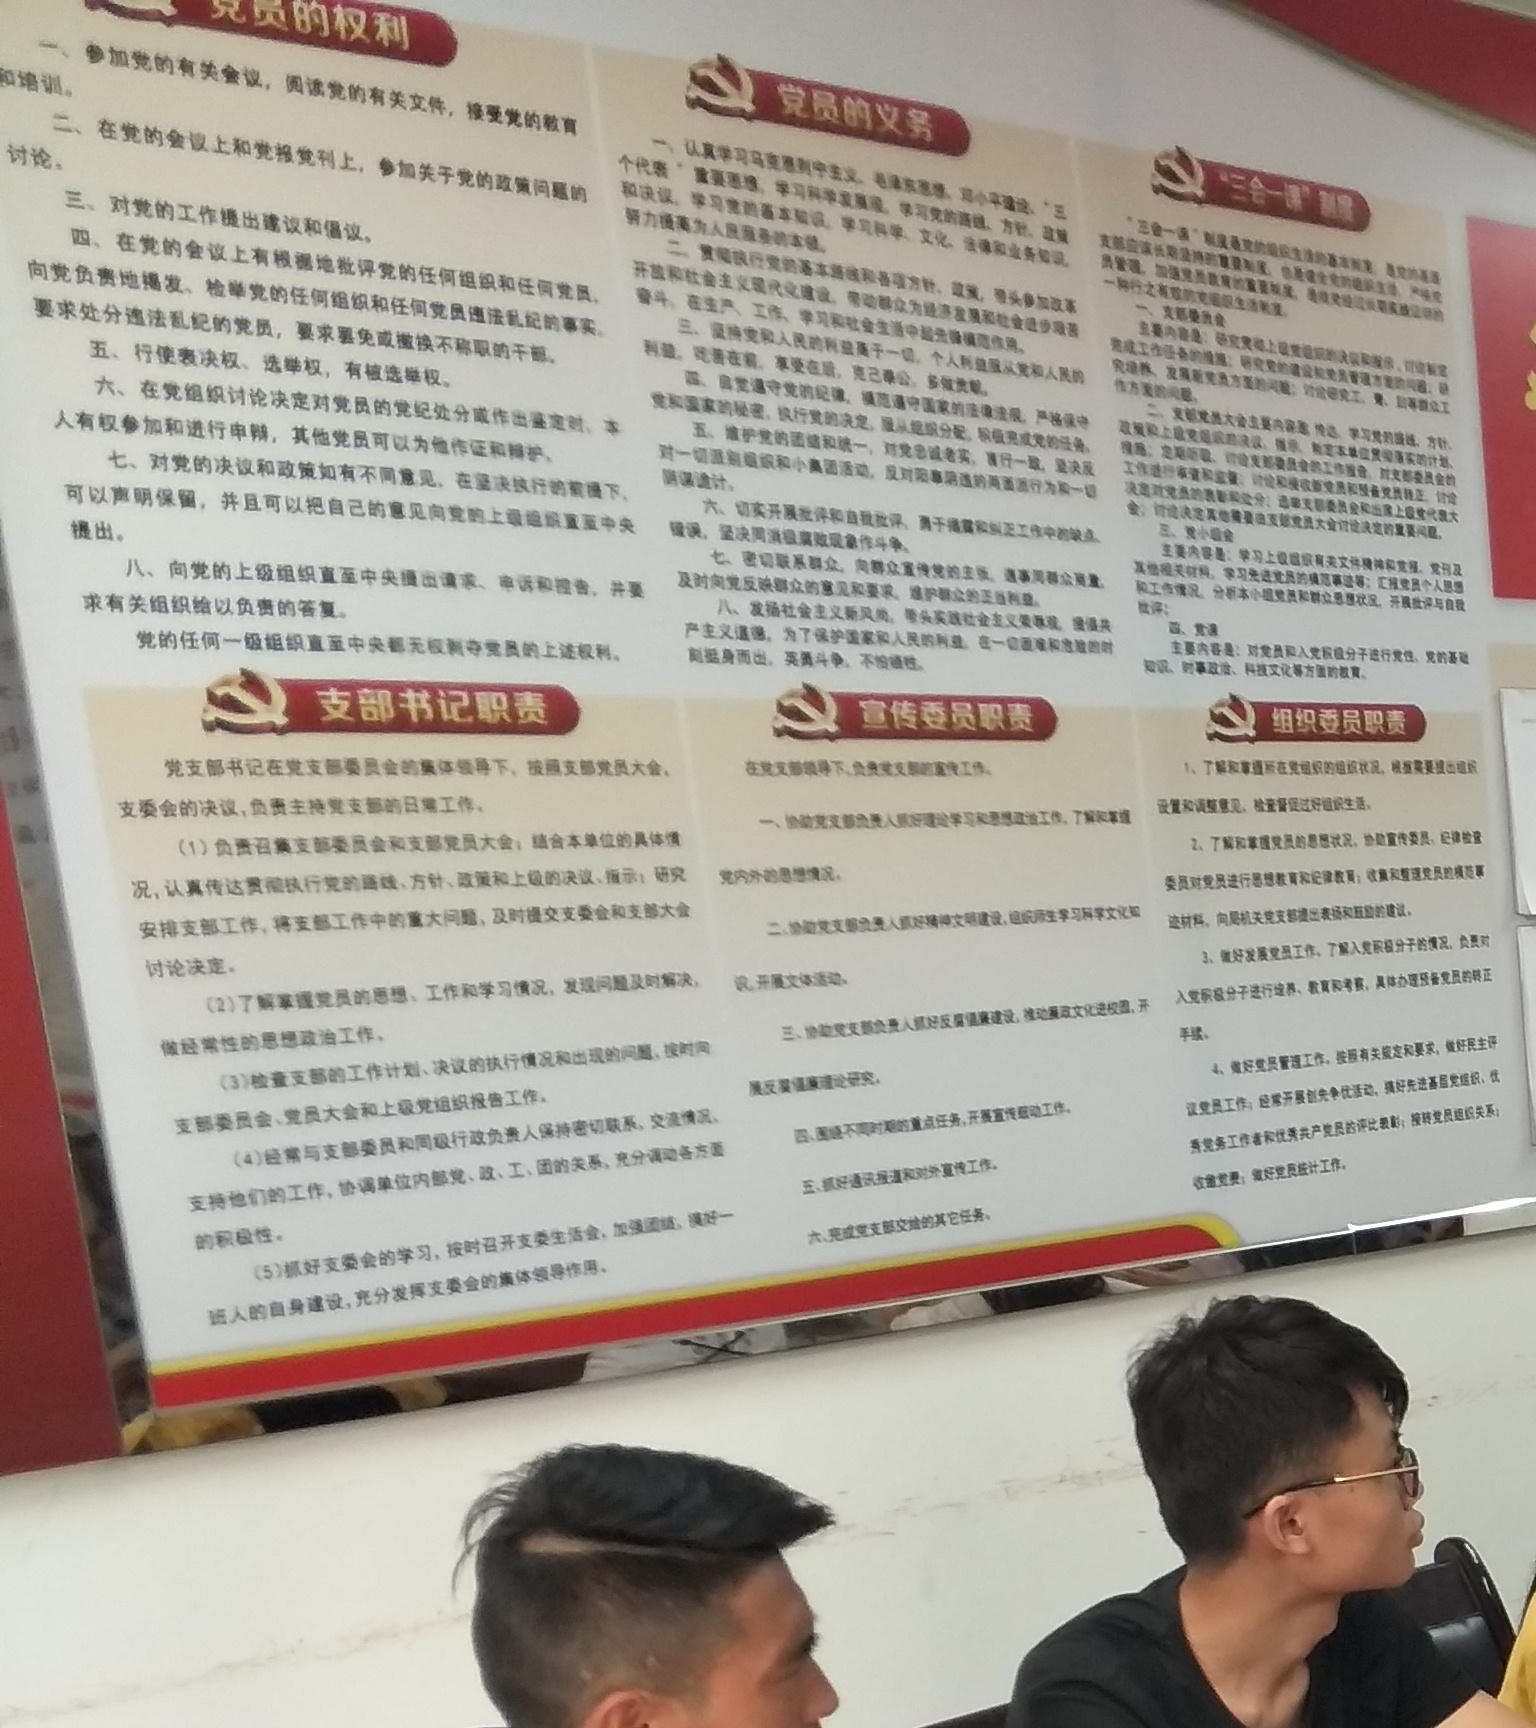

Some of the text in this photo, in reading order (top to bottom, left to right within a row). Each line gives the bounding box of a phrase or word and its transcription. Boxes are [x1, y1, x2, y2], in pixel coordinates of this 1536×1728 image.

[777, 83, 934, 142] 党员的义务
[316, 687, 548, 727] 支部书记职责
[859, 699, 1034, 733] 宣传委员职责
[1272, 707, 1407, 736] 组织委员职责
